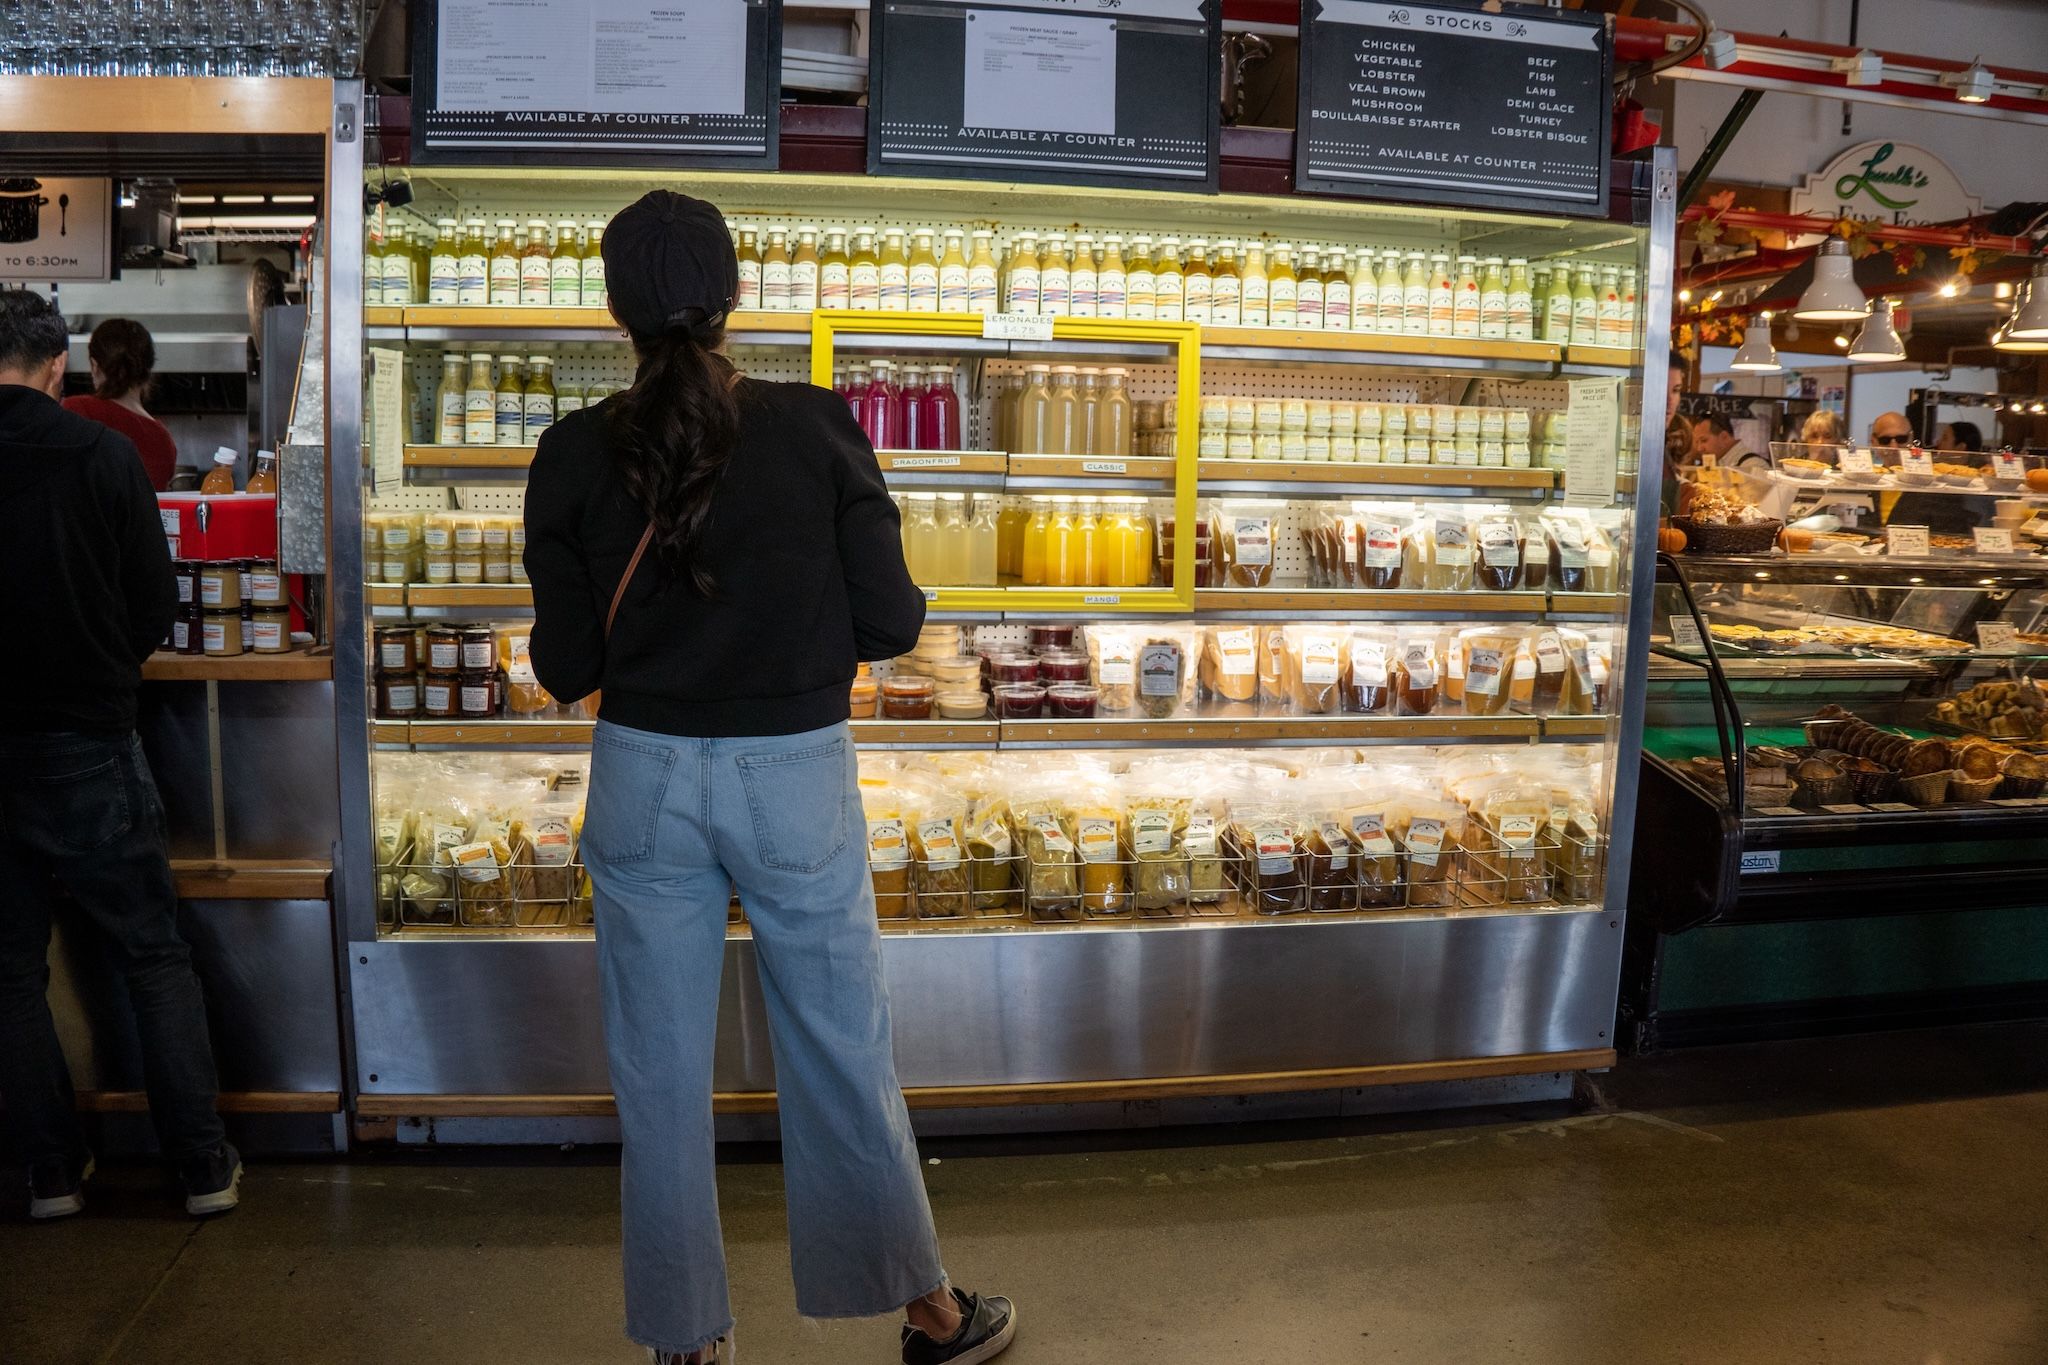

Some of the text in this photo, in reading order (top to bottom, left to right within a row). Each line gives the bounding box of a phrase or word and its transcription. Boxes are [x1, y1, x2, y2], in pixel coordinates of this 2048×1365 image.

[1424, 14, 1493, 33] STOCKS
[1361, 39, 1416, 52] CHICKEN
[1354, 53, 1423, 69] VEGETABLE
[1527, 56, 1557, 68] BEEF
[1361, 69, 1416, 83] LOBSTER
[1528, 71, 1555, 83] FISH
[1348, 82, 1426, 98] VEAL BROWN
[1525, 85, 1557, 97] LAMB
[1351, 98, 1423, 112] MUSHROOM
[1506, 98, 1575, 114] DEMI GLACE
[504, 112, 690, 125] AVAILABLE AT COUNTER
[1311, 109, 1461, 131] BOUILLABAISSE STARTER
[1518, 114, 1562, 127] TURKEY
[957, 127, 1136, 148] AVAILABLE AT COUNTER
[1490, 126, 1588, 145] LOBSTER BISQUE
[1377, 147, 1538, 171] AVAILABLE AT COUNTER
[5, 256, 78, 267] TO 6:30PM
[985, 315, 1053, 325] LEMONADES
[892, 457, 959, 466] DRAGONFRUIT
[1086, 463, 1125, 471] CLASSIC
